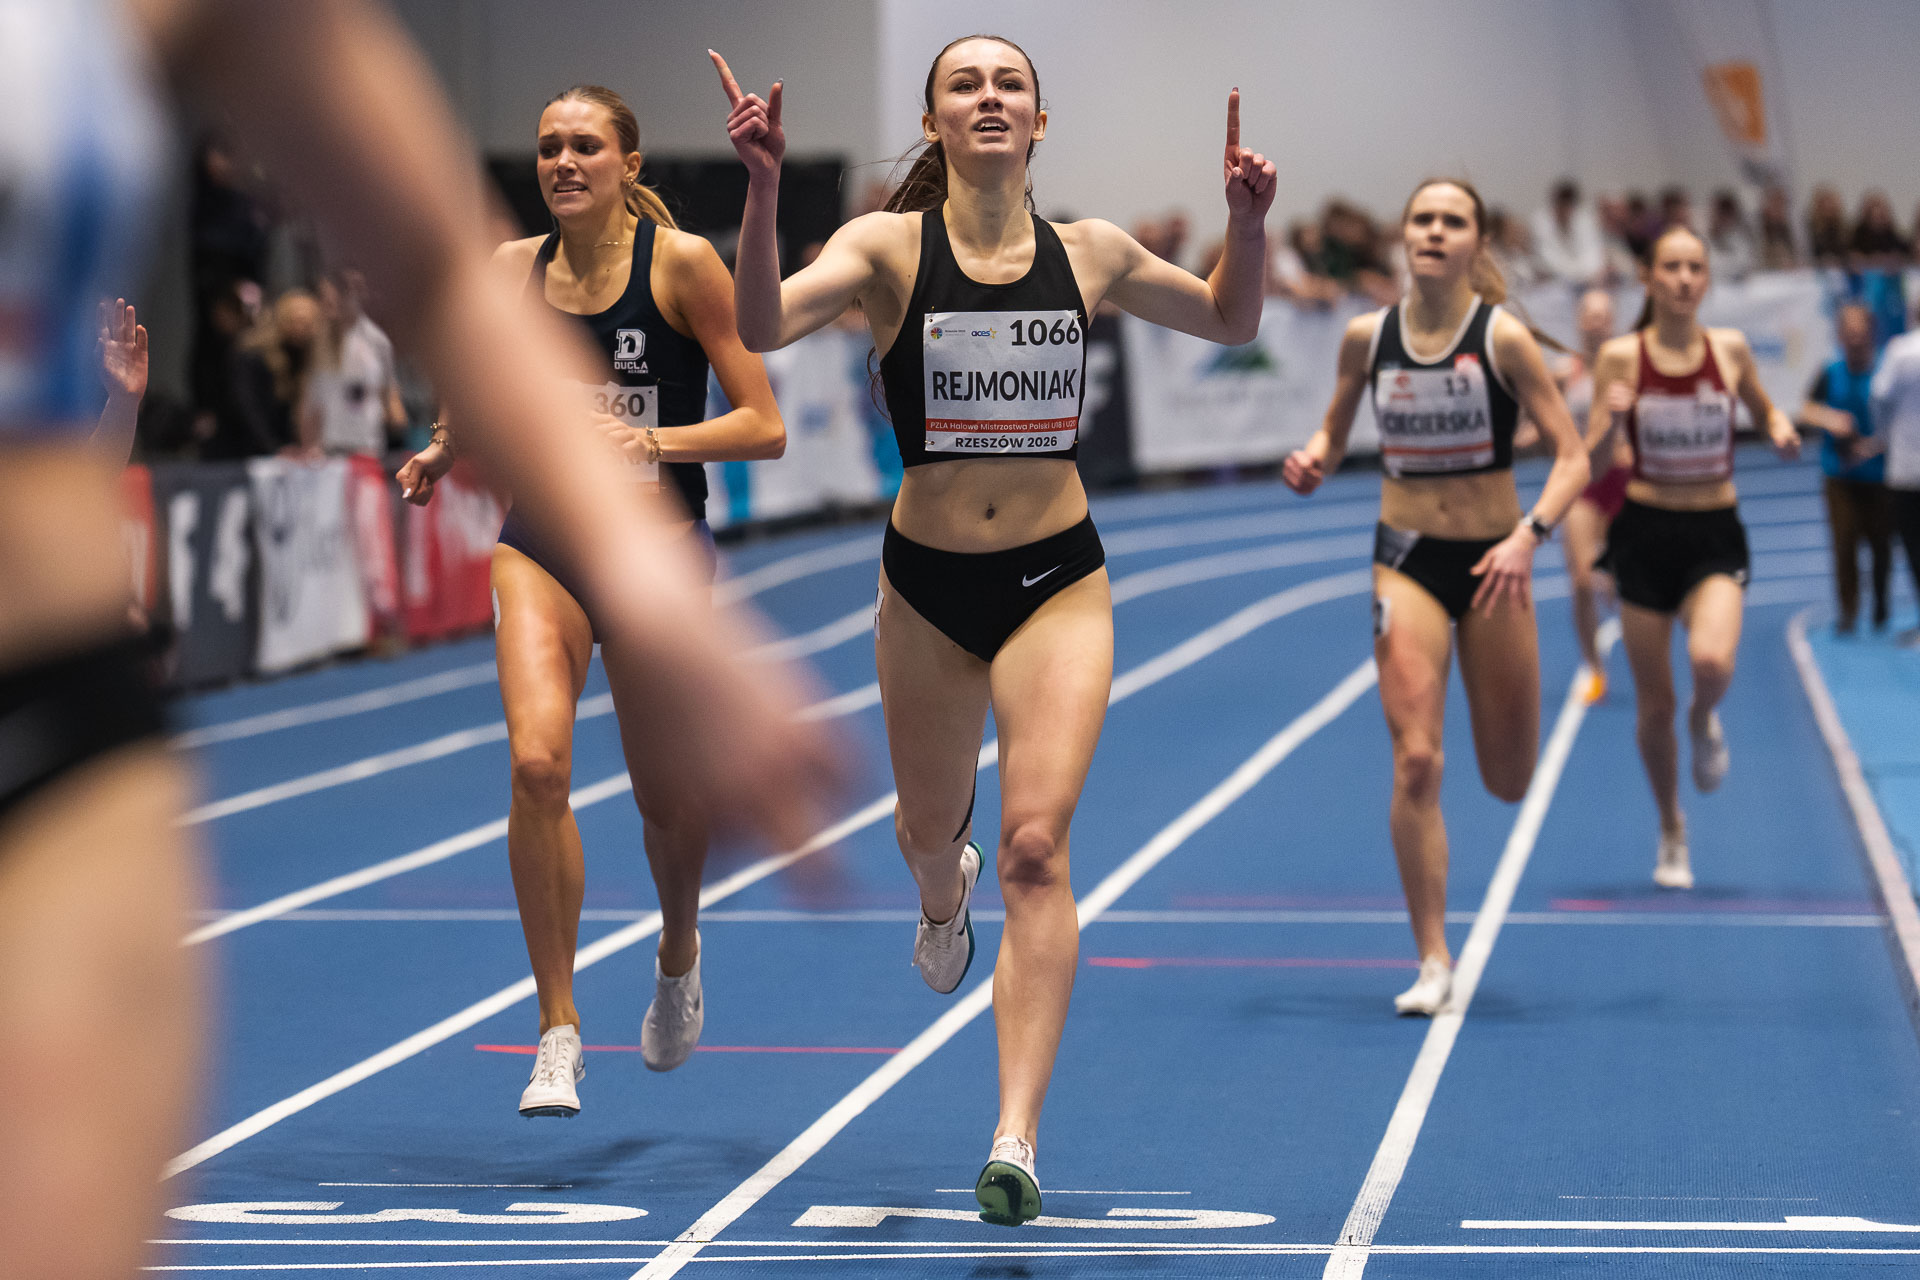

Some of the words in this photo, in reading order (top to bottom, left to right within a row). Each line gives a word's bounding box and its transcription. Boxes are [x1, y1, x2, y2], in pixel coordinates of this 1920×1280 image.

[971, 329, 991, 337] aces
[1009, 318, 1080, 347] 1066
[614, 361, 648, 370] DUCLA
[932, 368, 1078, 402] REJMONIAK
[930, 421, 948, 430] PZLA
[950, 422, 978, 430] Halowe
[980, 423, 1028, 431] Mistrzostwa
[1029, 421, 1050, 430] Polski
[1051, 420, 1062, 429] U18
[955, 434, 1024, 449] RZESZÓW
[1027, 436, 1058, 448] 2026
